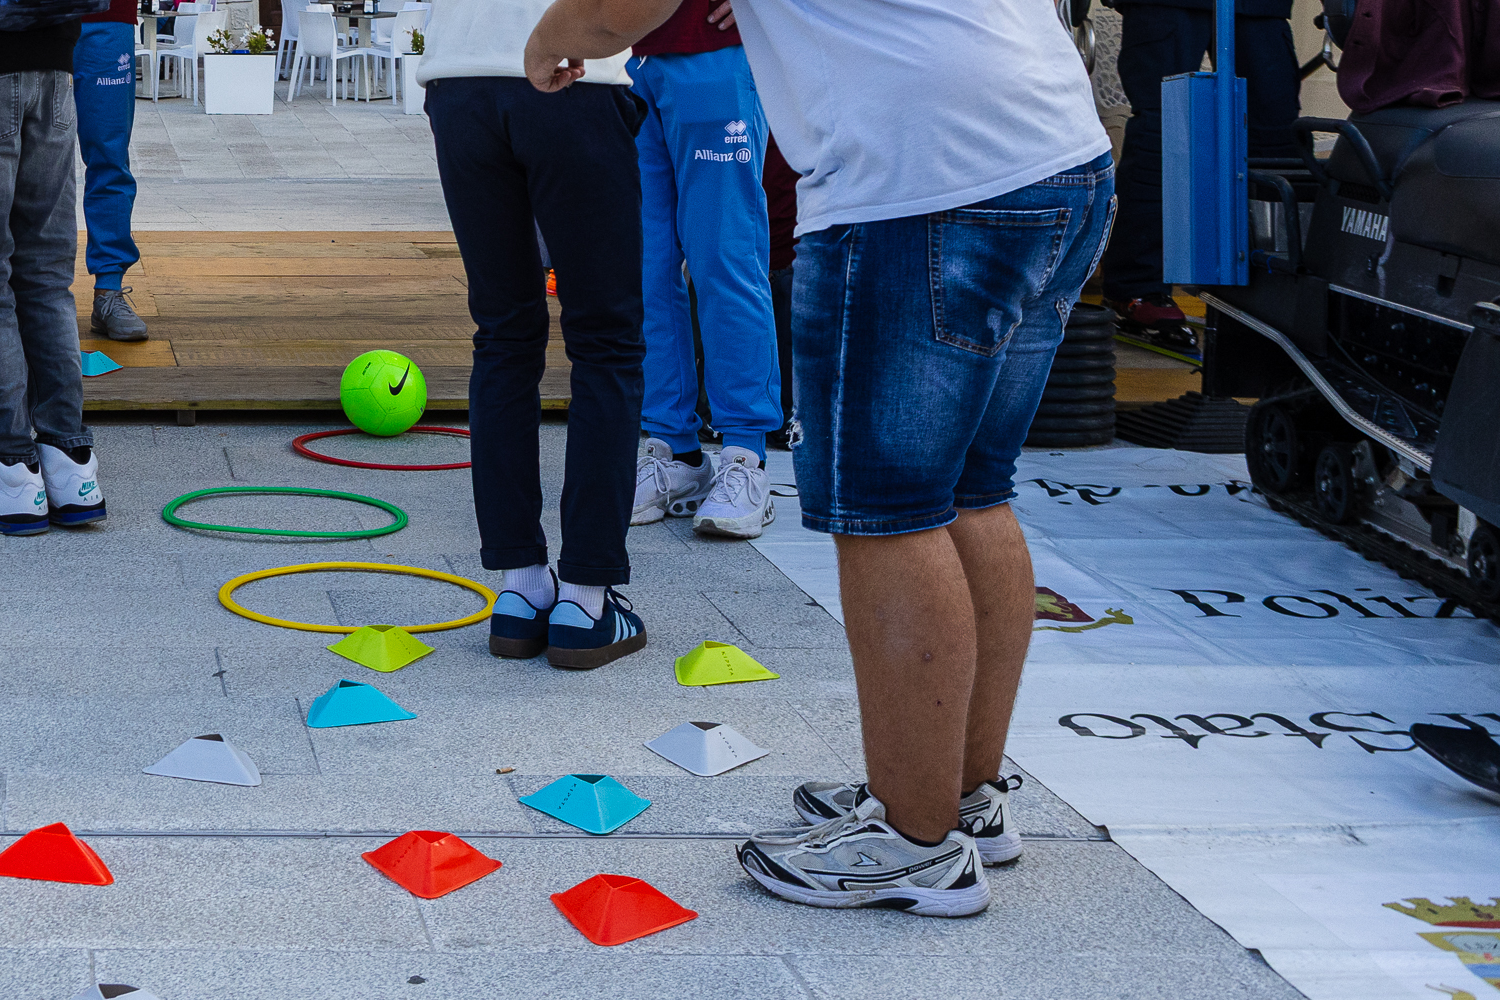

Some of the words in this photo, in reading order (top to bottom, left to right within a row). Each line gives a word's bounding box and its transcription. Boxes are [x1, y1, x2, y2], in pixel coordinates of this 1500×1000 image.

[96, 77, 126, 86] Allianz
[694, 149, 734, 162] Allianz
[1341, 205, 1389, 242] YAMAHA
[81, 480, 96, 491] NIKE
[908, 860, 933, 874] power
